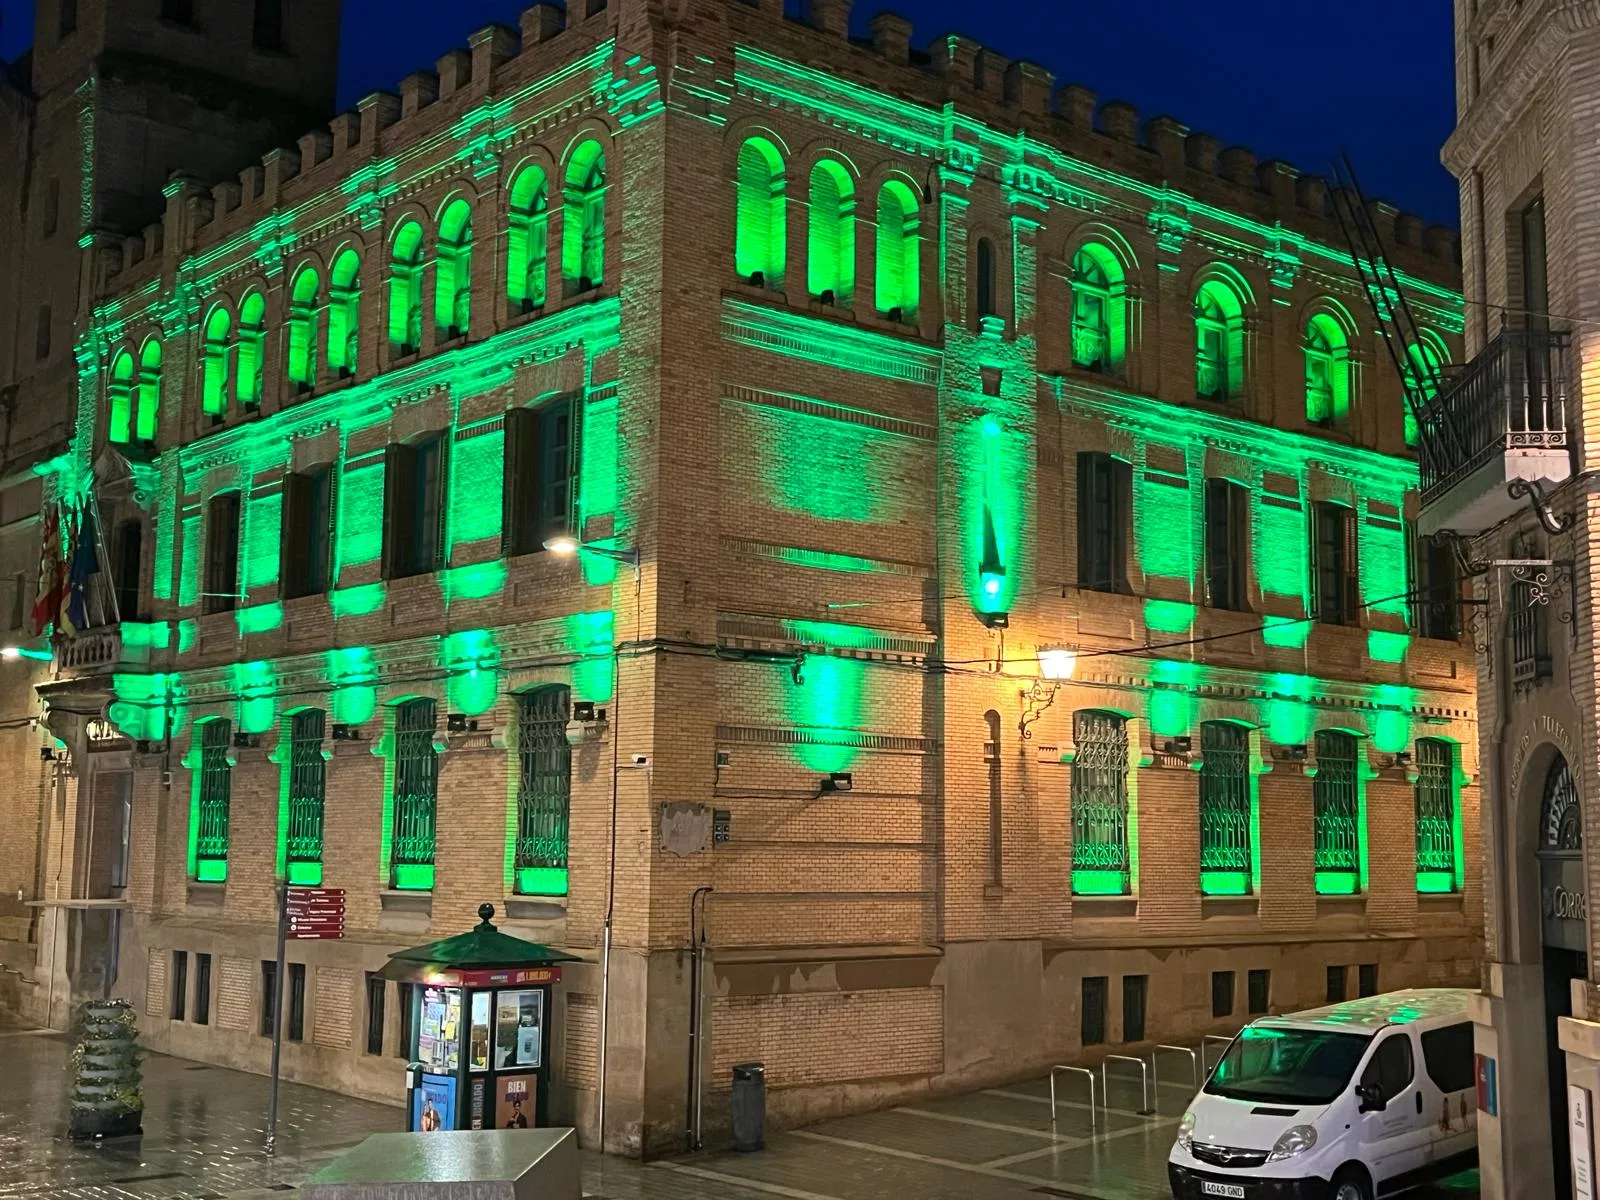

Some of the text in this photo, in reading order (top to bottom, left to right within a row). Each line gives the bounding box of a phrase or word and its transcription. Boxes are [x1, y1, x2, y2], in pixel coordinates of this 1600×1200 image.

[507, 1080, 526, 1093] BIEN
[1206, 1183, 1243, 1197] 4049 GND
